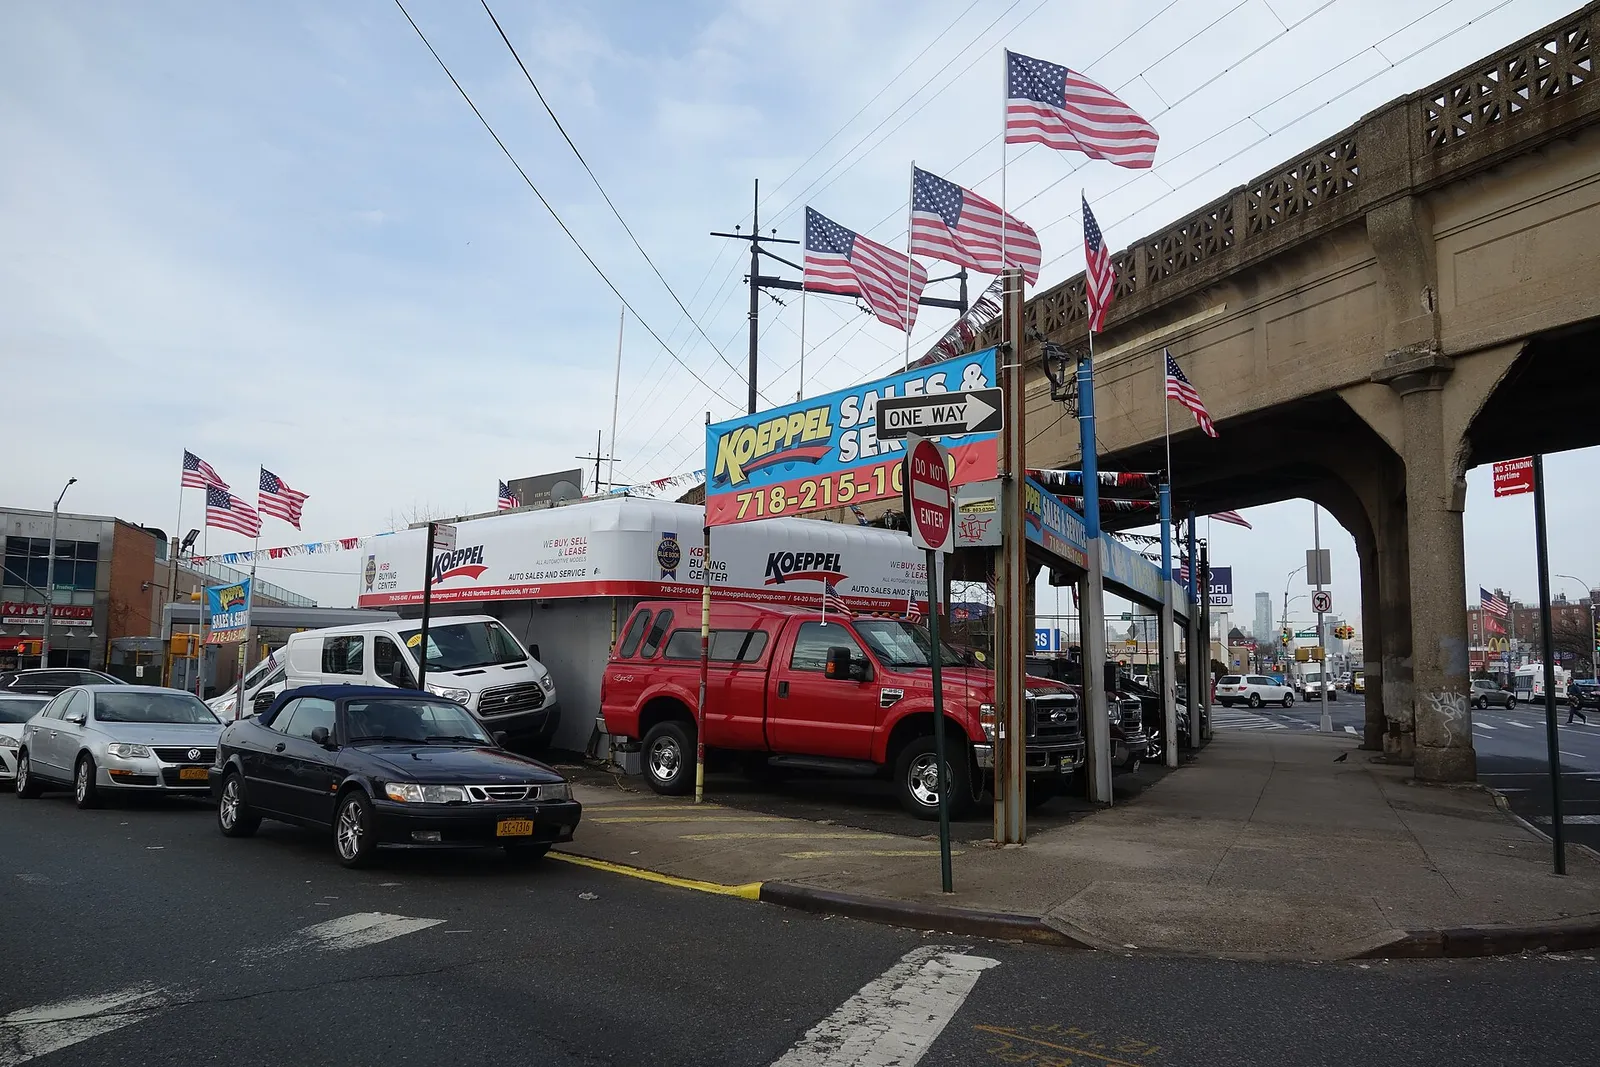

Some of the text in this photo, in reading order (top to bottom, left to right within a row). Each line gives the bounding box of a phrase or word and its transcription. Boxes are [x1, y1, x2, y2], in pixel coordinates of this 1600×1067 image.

[959, 362, 989, 391] &
[889, 404, 968, 427] ONE WAY
[714, 405, 833, 486] KOEPPEL
[915, 457, 944, 483] DO NOT
[1494, 466, 1504, 474] NO
[1495, 472, 1520, 482] Anytime
[920, 507, 944, 529] ENTER
[1043, 495, 1061, 533] SALES
[543, 536, 588, 549] WE BUY, SELL
[558, 546, 587, 557] & LEASE
[689, 547, 704, 557] KB
[380, 562, 390, 571] KBB
[432, 544, 484, 584] KOEPPEL
[543, 557, 569, 565] AUTOMOTIVE
[890, 561, 901, 569] WE
[901, 561, 916, 571] BUY,
[508, 568, 586, 581] AUTO SALES AND SERVICE
[765, 551, 841, 585] KOEPPEL
[378, 571, 397, 581] BUYING
[911, 571, 928, 580] LEAS
[377, 580, 398, 590] CENTER
[851, 585, 870, 593] AUTO
[870, 586, 892, 595] SALES
[892, 588, 906, 596] AND
[220, 585, 245, 611] KOEPPEL
[660, 586, 700, 594] 718-215-1040
[793, 595, 809, 603] 54-20
[845, 598, 871, 607] Woodside,
[212, 613, 229, 629] SALES
